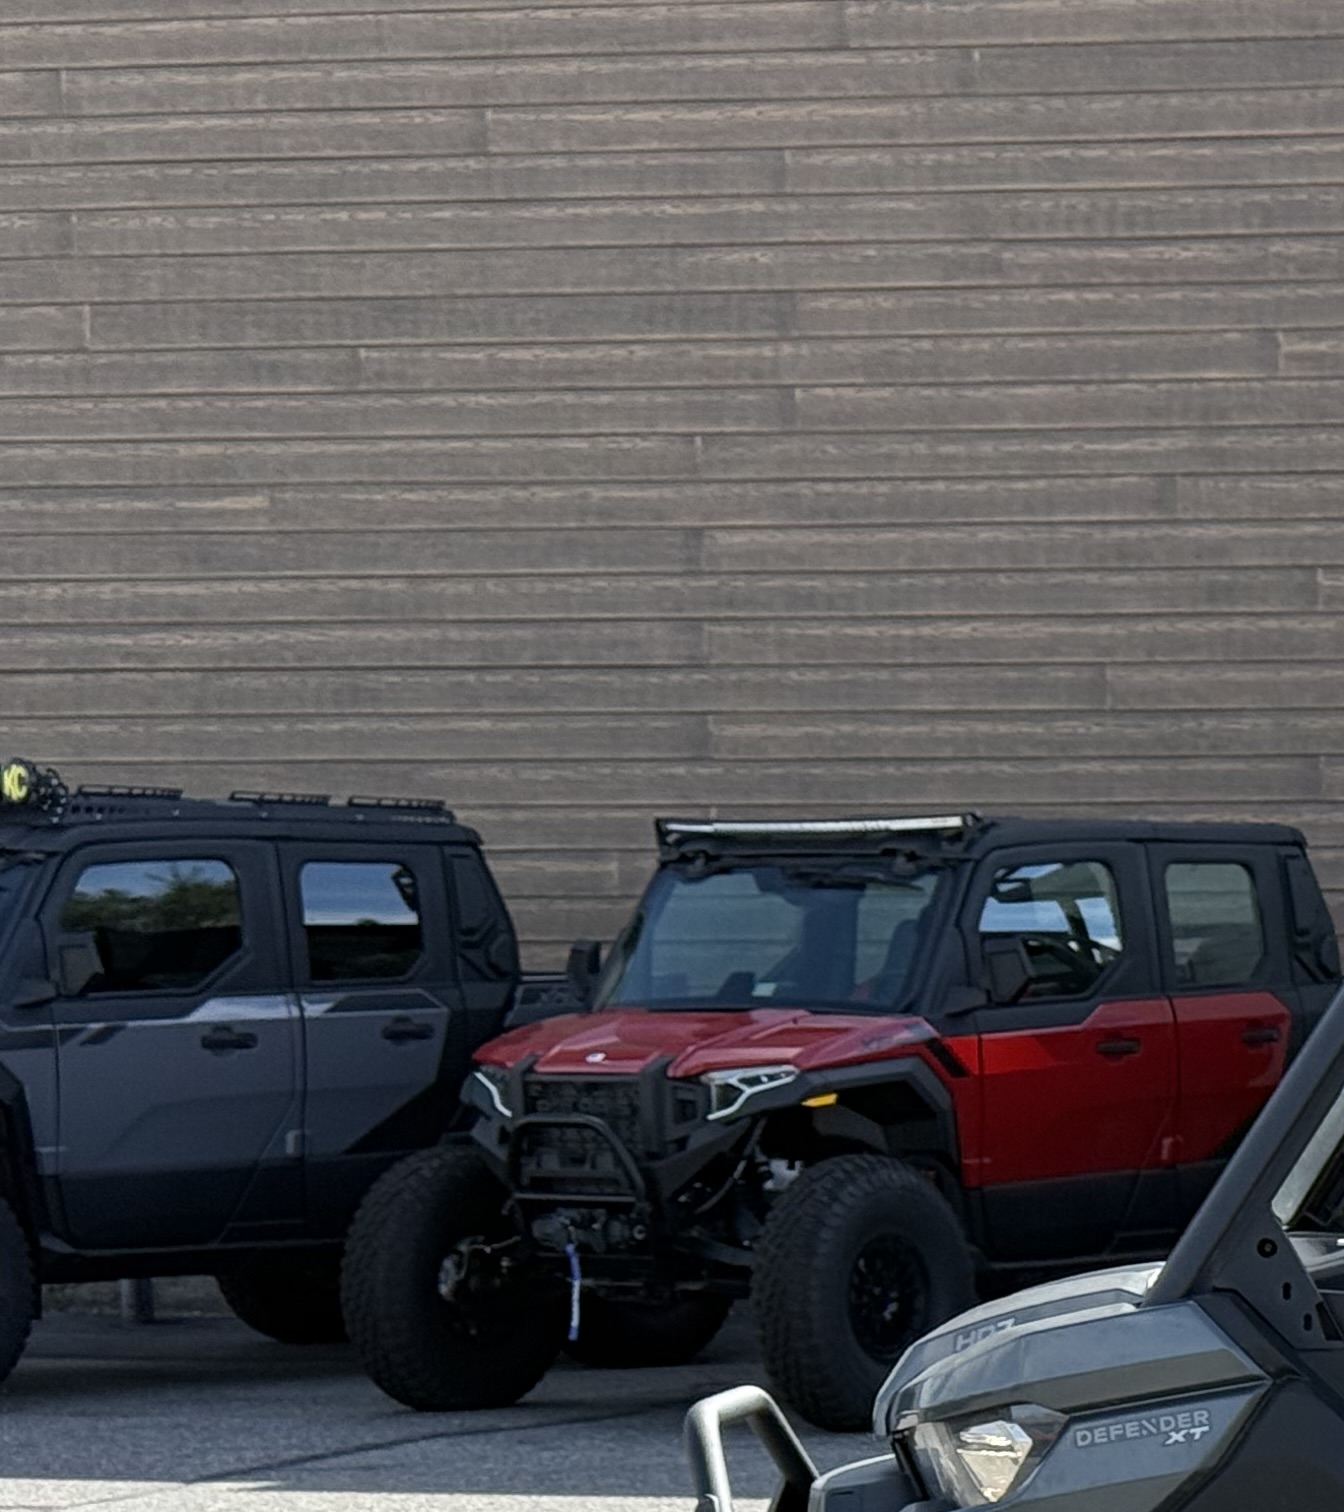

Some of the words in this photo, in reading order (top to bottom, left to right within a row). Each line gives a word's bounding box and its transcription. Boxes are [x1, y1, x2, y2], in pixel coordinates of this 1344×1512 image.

[3, 763, 29, 801] KC
[1075, 1410, 1210, 1447] DEFENDER
[1164, 1425, 1210, 1446] XT
